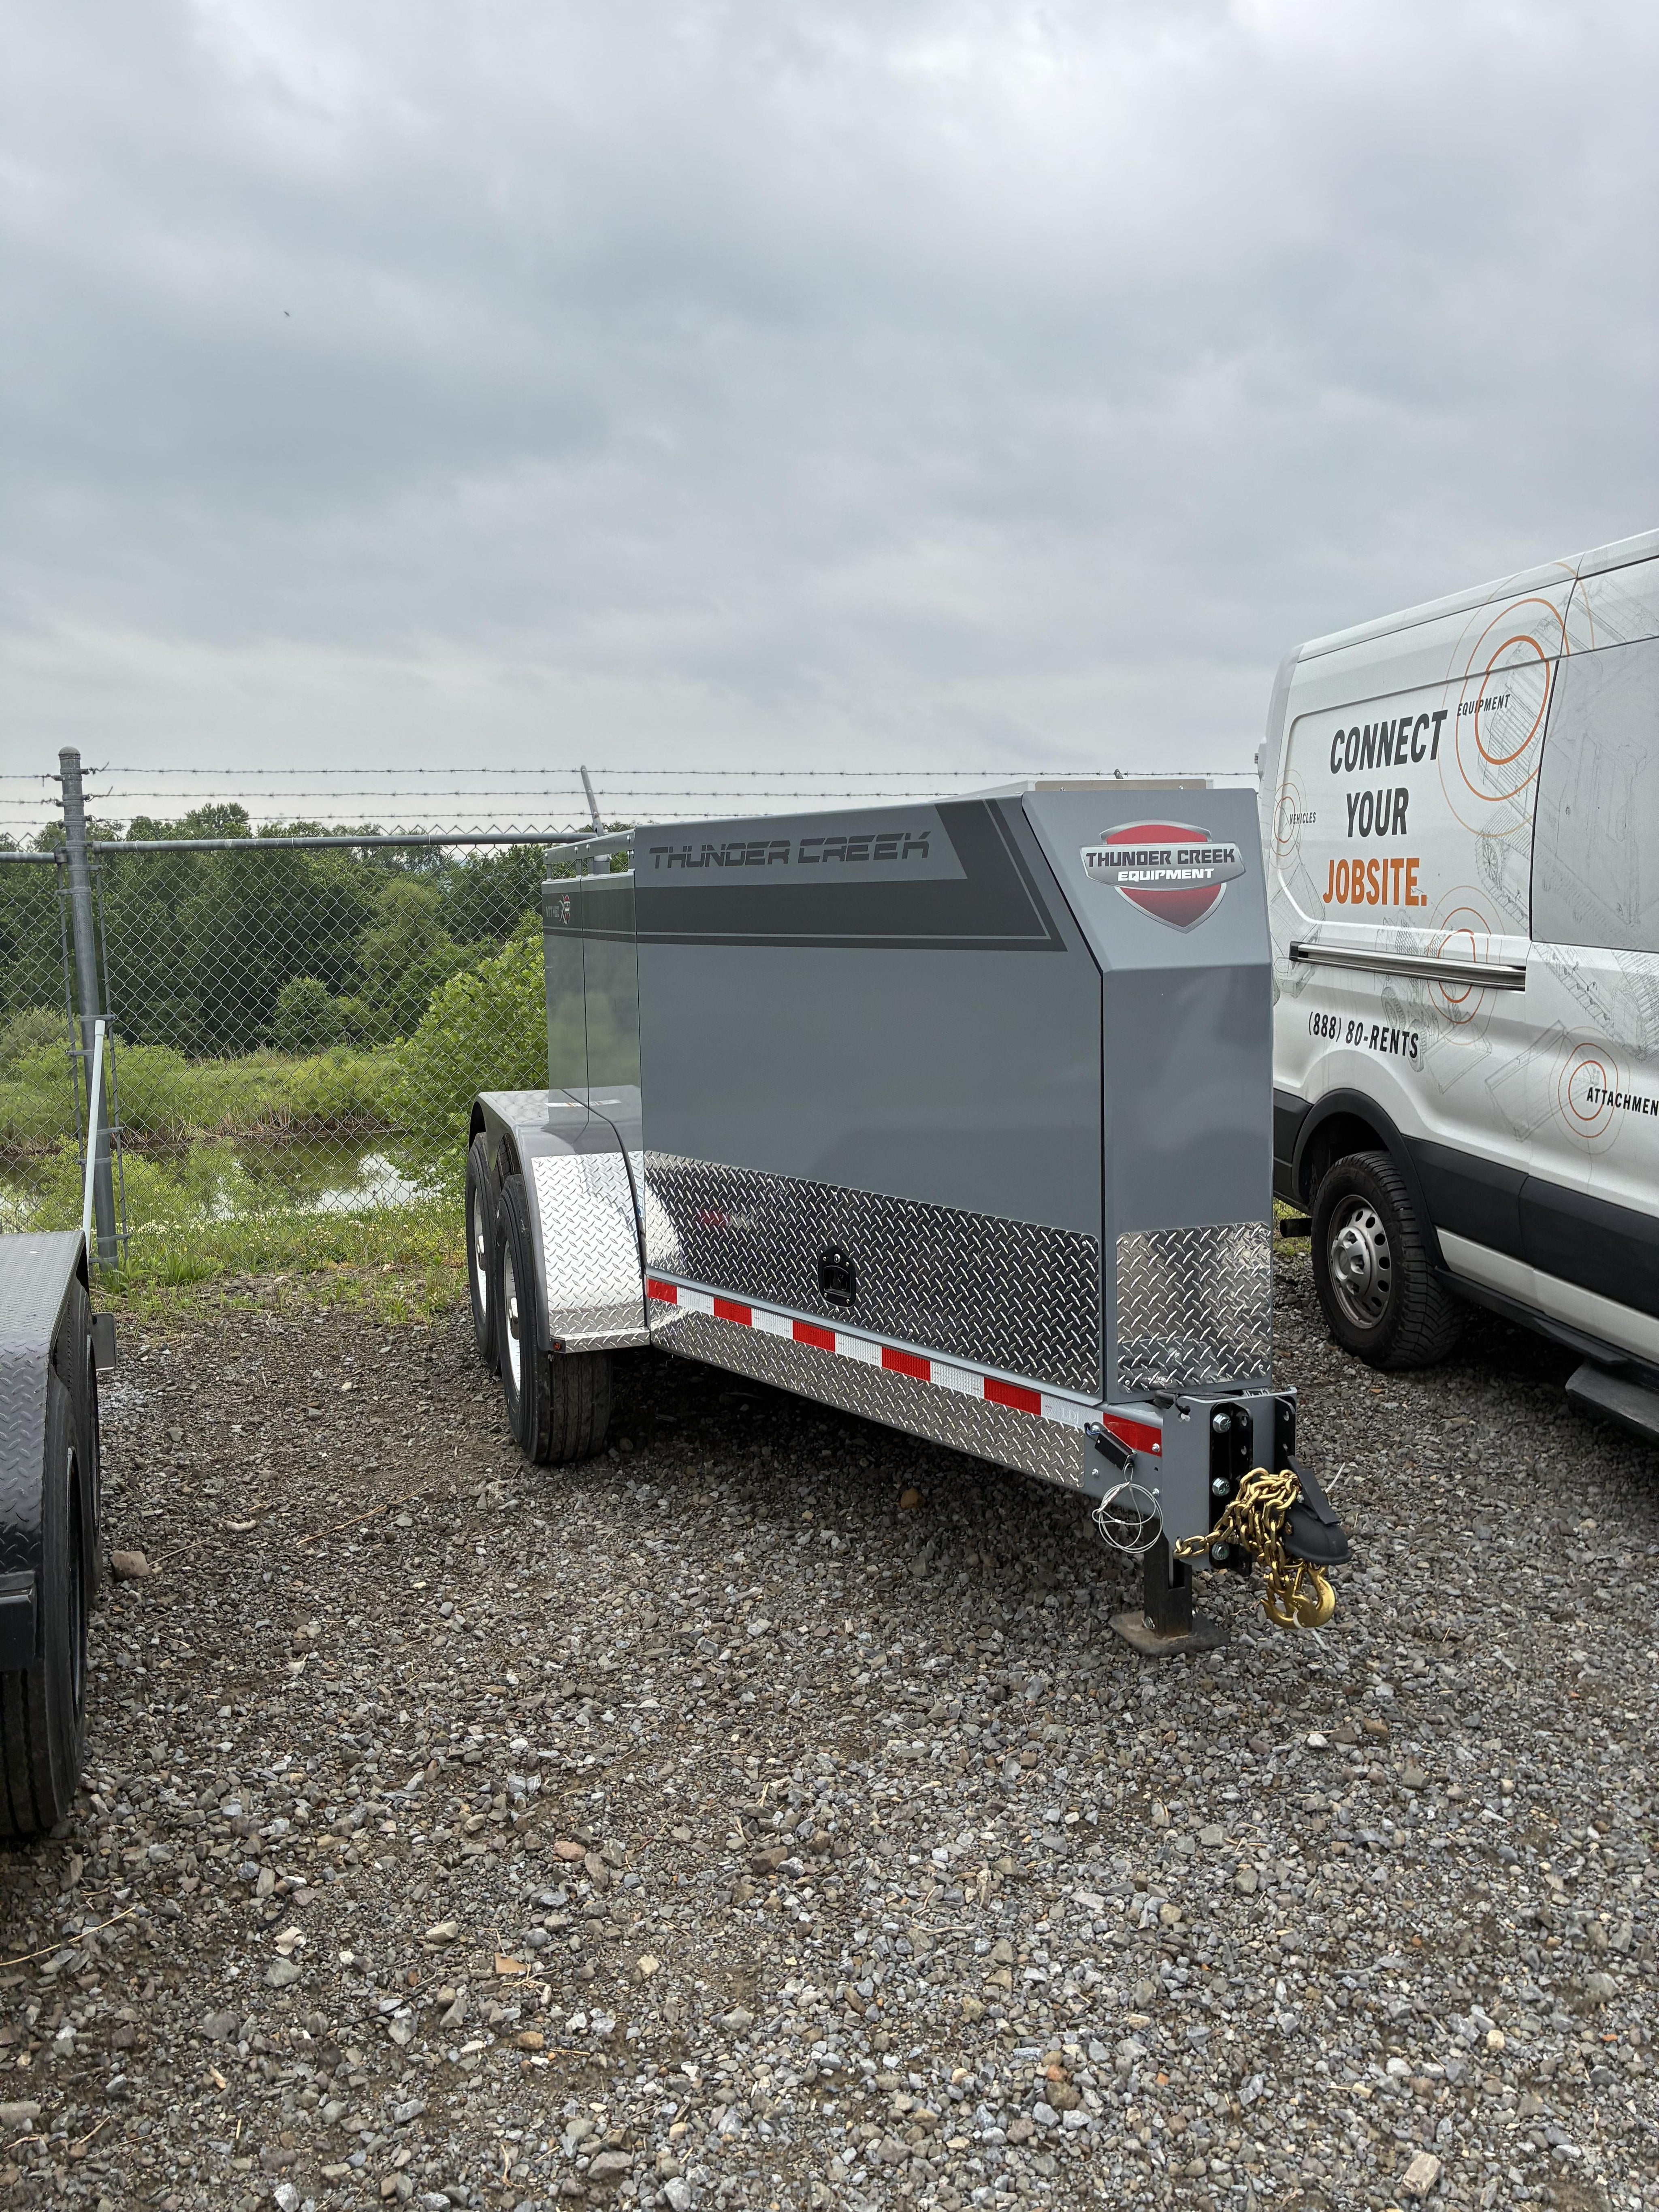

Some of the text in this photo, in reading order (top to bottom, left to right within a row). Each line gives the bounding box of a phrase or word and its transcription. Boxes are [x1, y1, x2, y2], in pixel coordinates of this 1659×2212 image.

[1457, 694, 1510, 717] EQUIPMENT
[1330, 709, 1448, 774] CONNECT
[1290, 812, 1316, 825] VEHICLES
[1346, 787, 1409, 838] YOUR
[649, 831, 931, 869] THUNDER CREEK
[1085, 848, 1235, 867] THUNDER CREEK
[1117, 868, 1215, 882] EQUIPMENT
[1322, 857, 1427, 906] JOBSITE.
[1309, 1011, 1419, 1059] (888) 80-RENTS
[1586, 1087, 1659, 1116] ATTACHMEN
